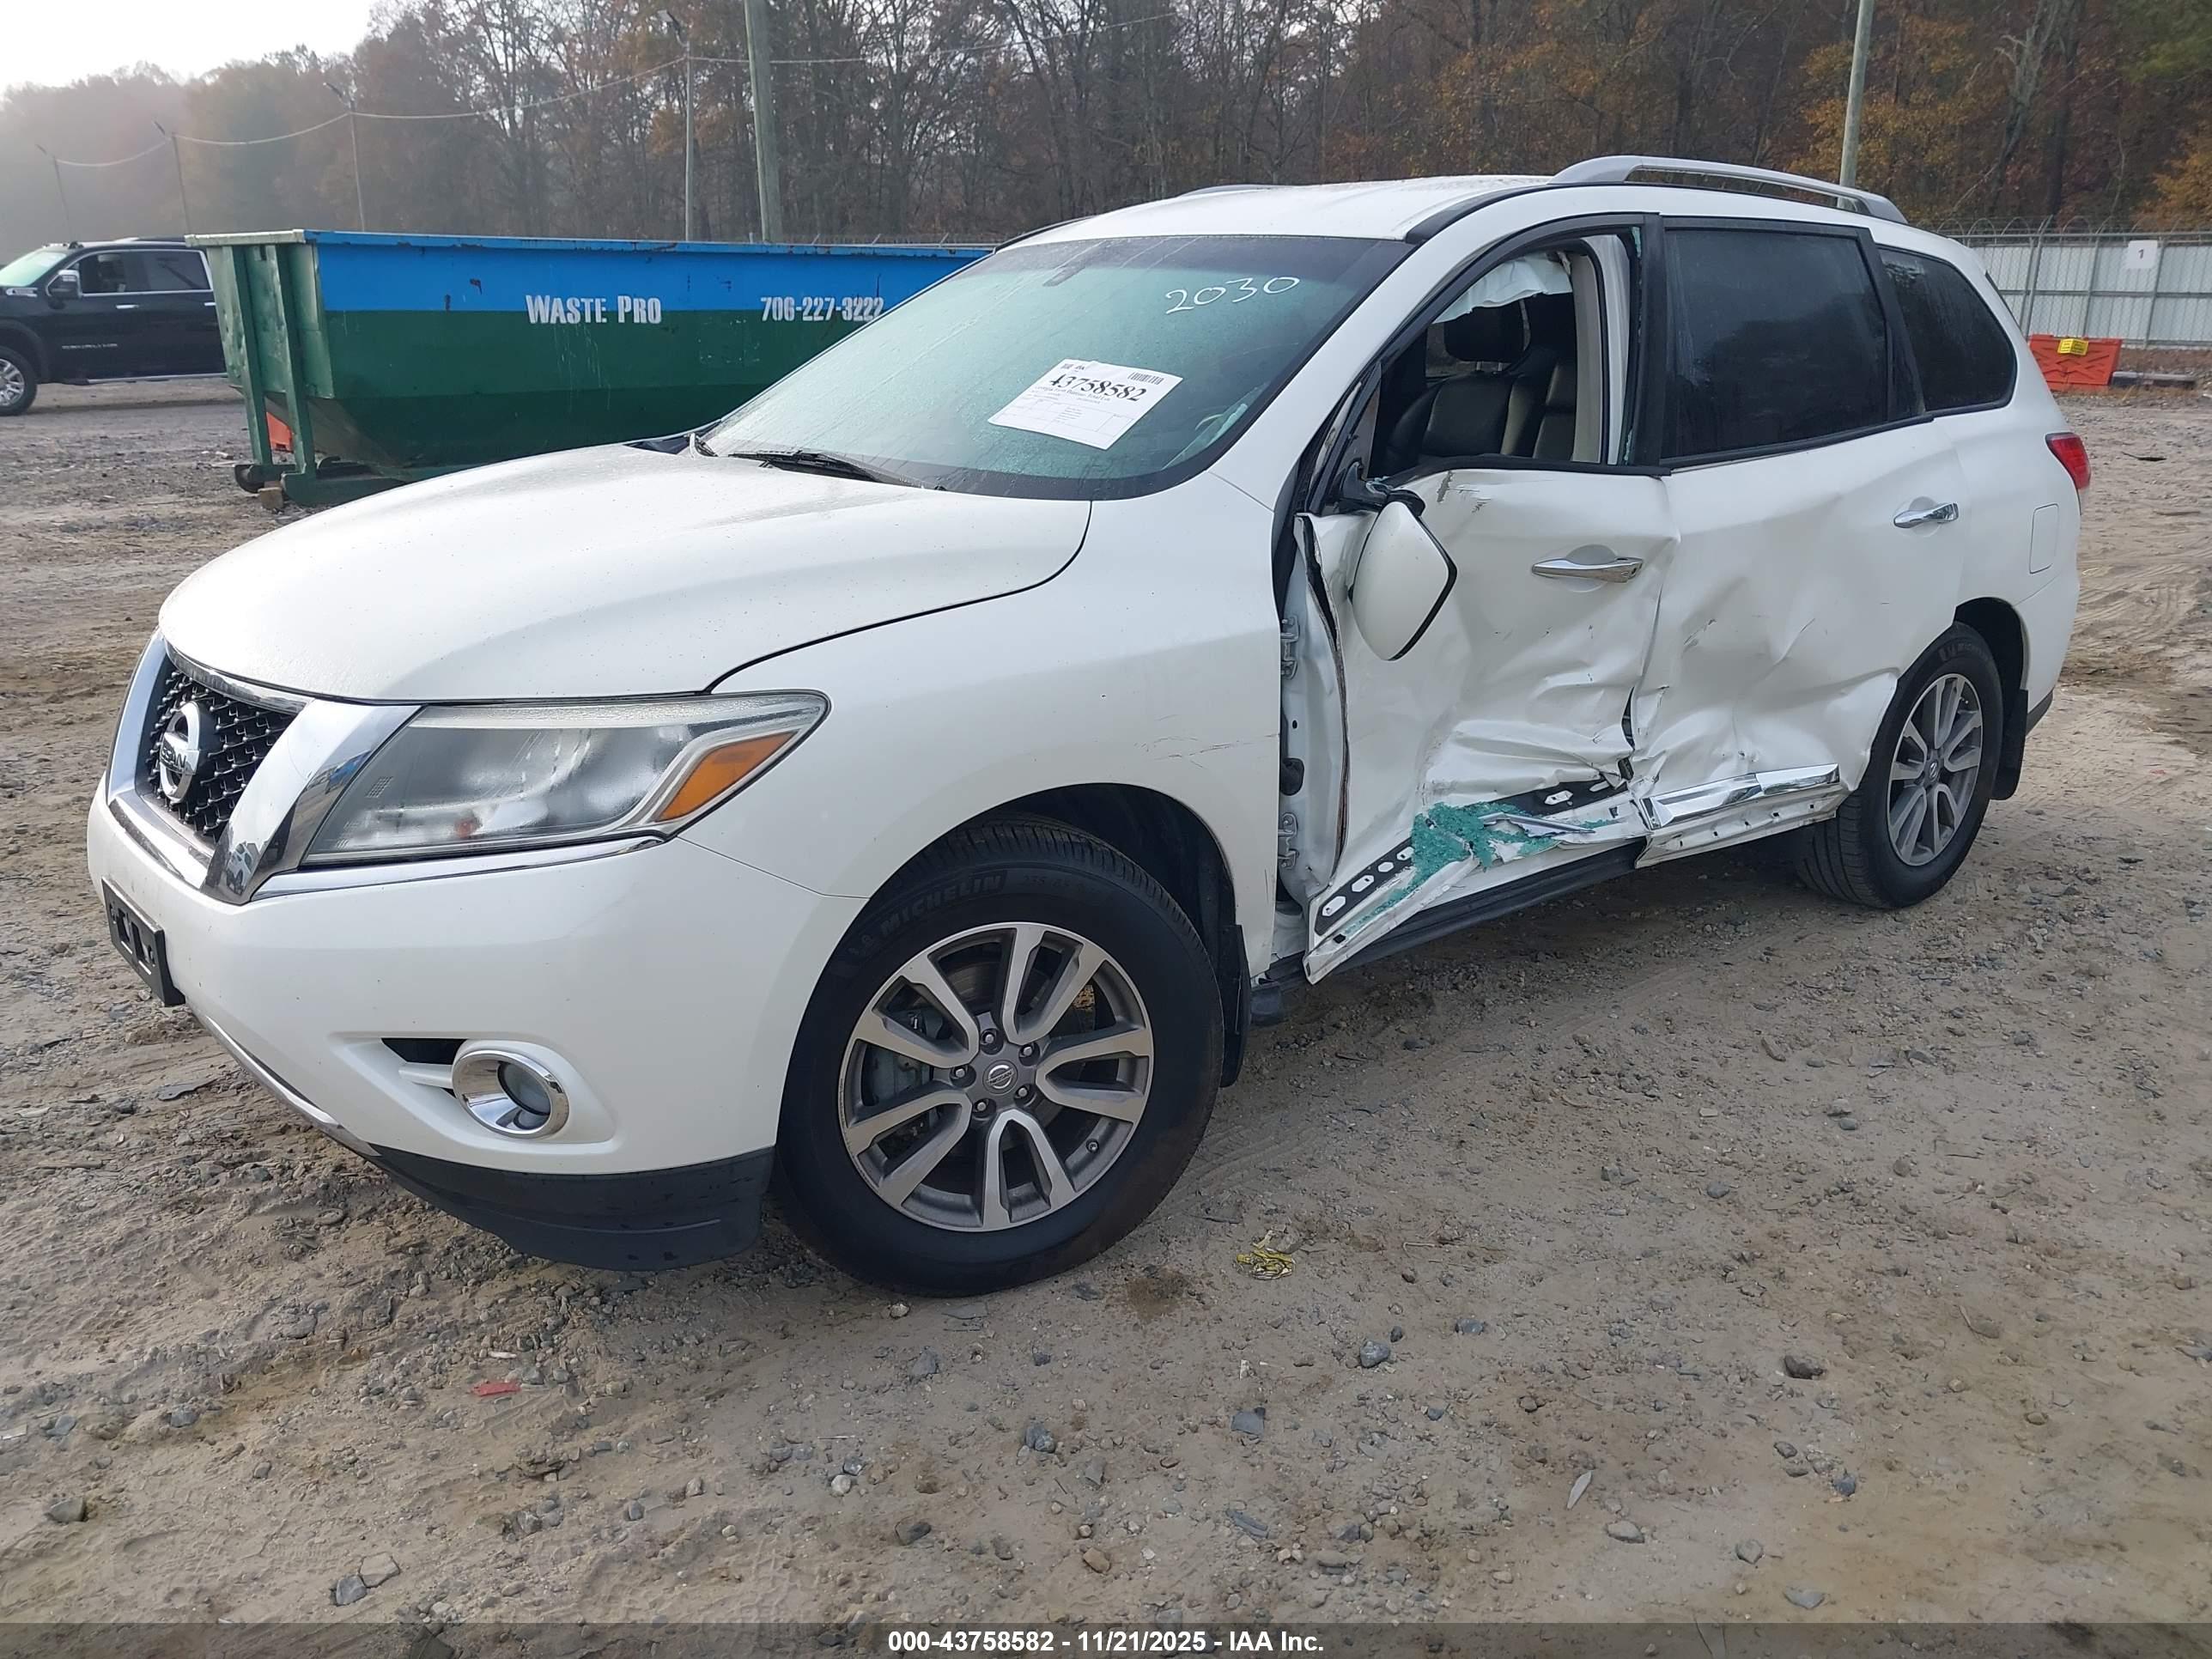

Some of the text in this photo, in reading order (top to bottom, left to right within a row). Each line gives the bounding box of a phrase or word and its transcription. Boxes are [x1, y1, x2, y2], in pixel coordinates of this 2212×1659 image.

[760, 296, 885, 322] 706-227-3222
[1164, 276, 1301, 314] 2030
[1048, 374, 1148, 402] 43758582
[879, 874, 1002, 936] MICHELIN
